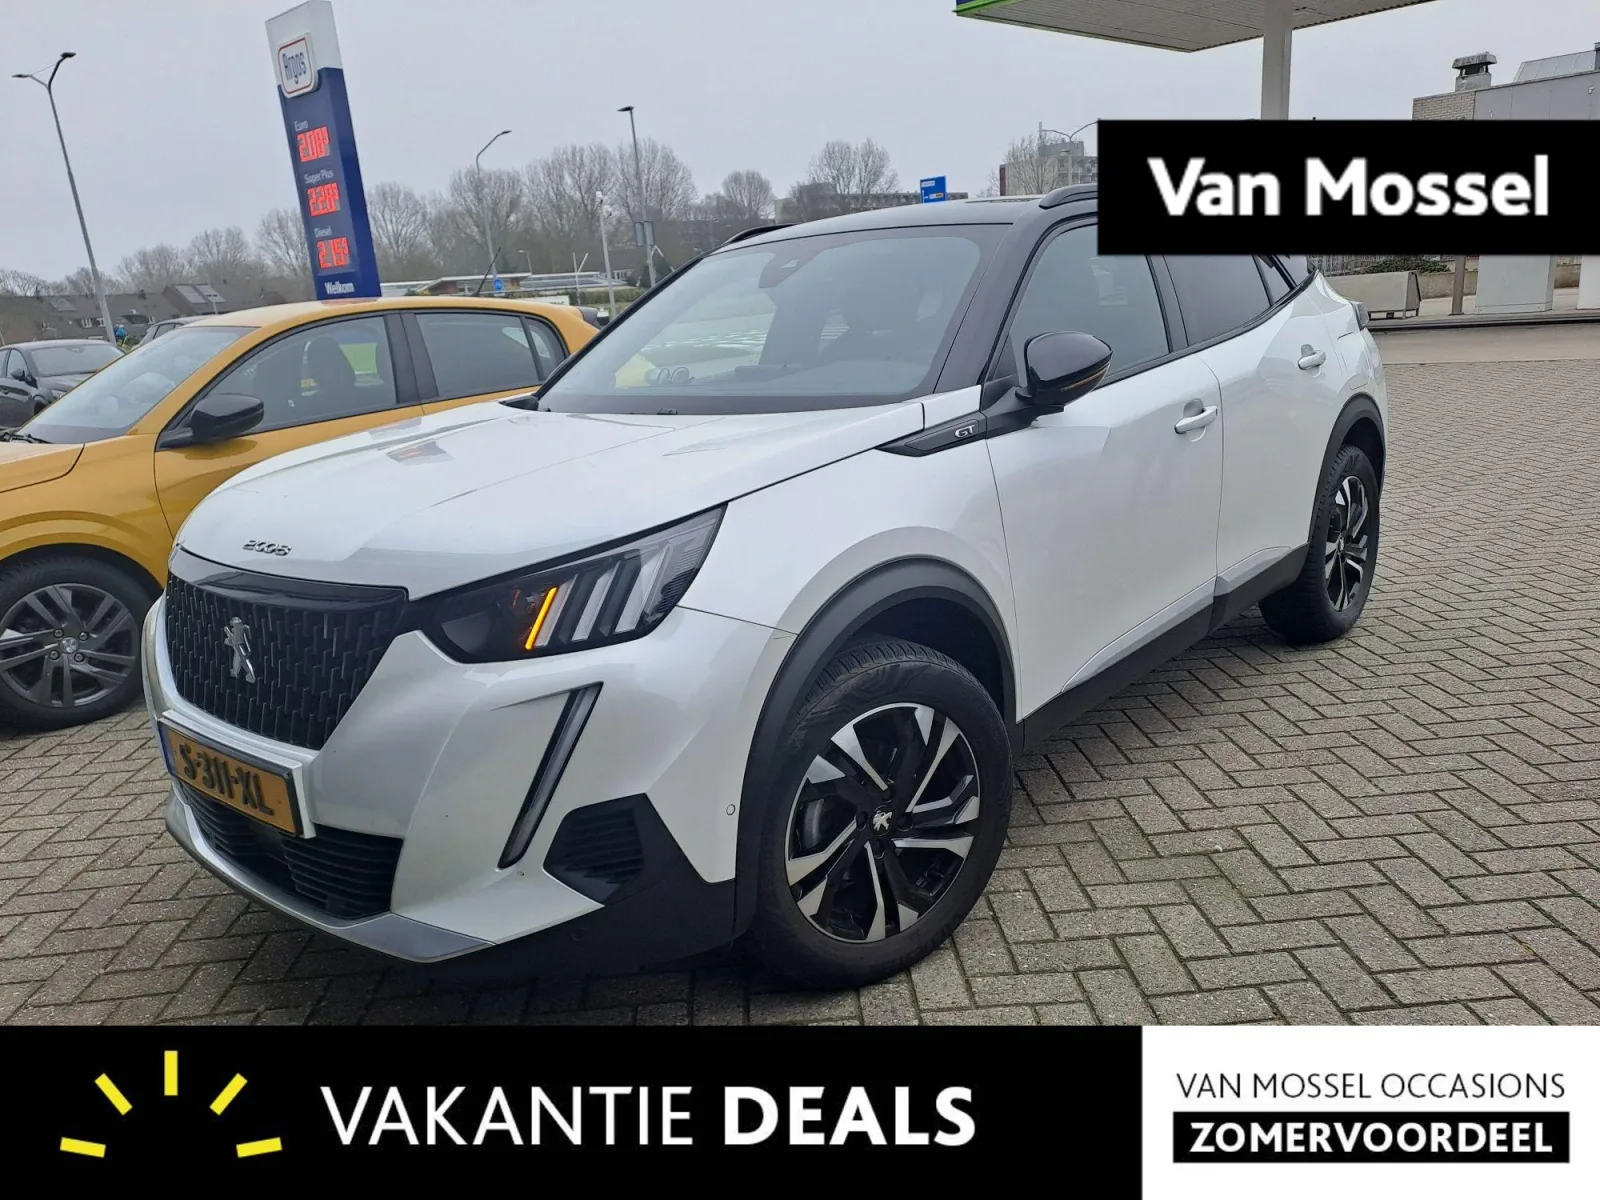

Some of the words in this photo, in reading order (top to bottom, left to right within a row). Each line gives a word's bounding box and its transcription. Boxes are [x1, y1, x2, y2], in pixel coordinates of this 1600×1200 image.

[282, 51, 307, 84] Argos
[324, 281, 354, 295] Welkom
[955, 424, 976, 438] GT
[242, 540, 291, 556] 2008
[179, 743, 275, 816] S-311-XL
